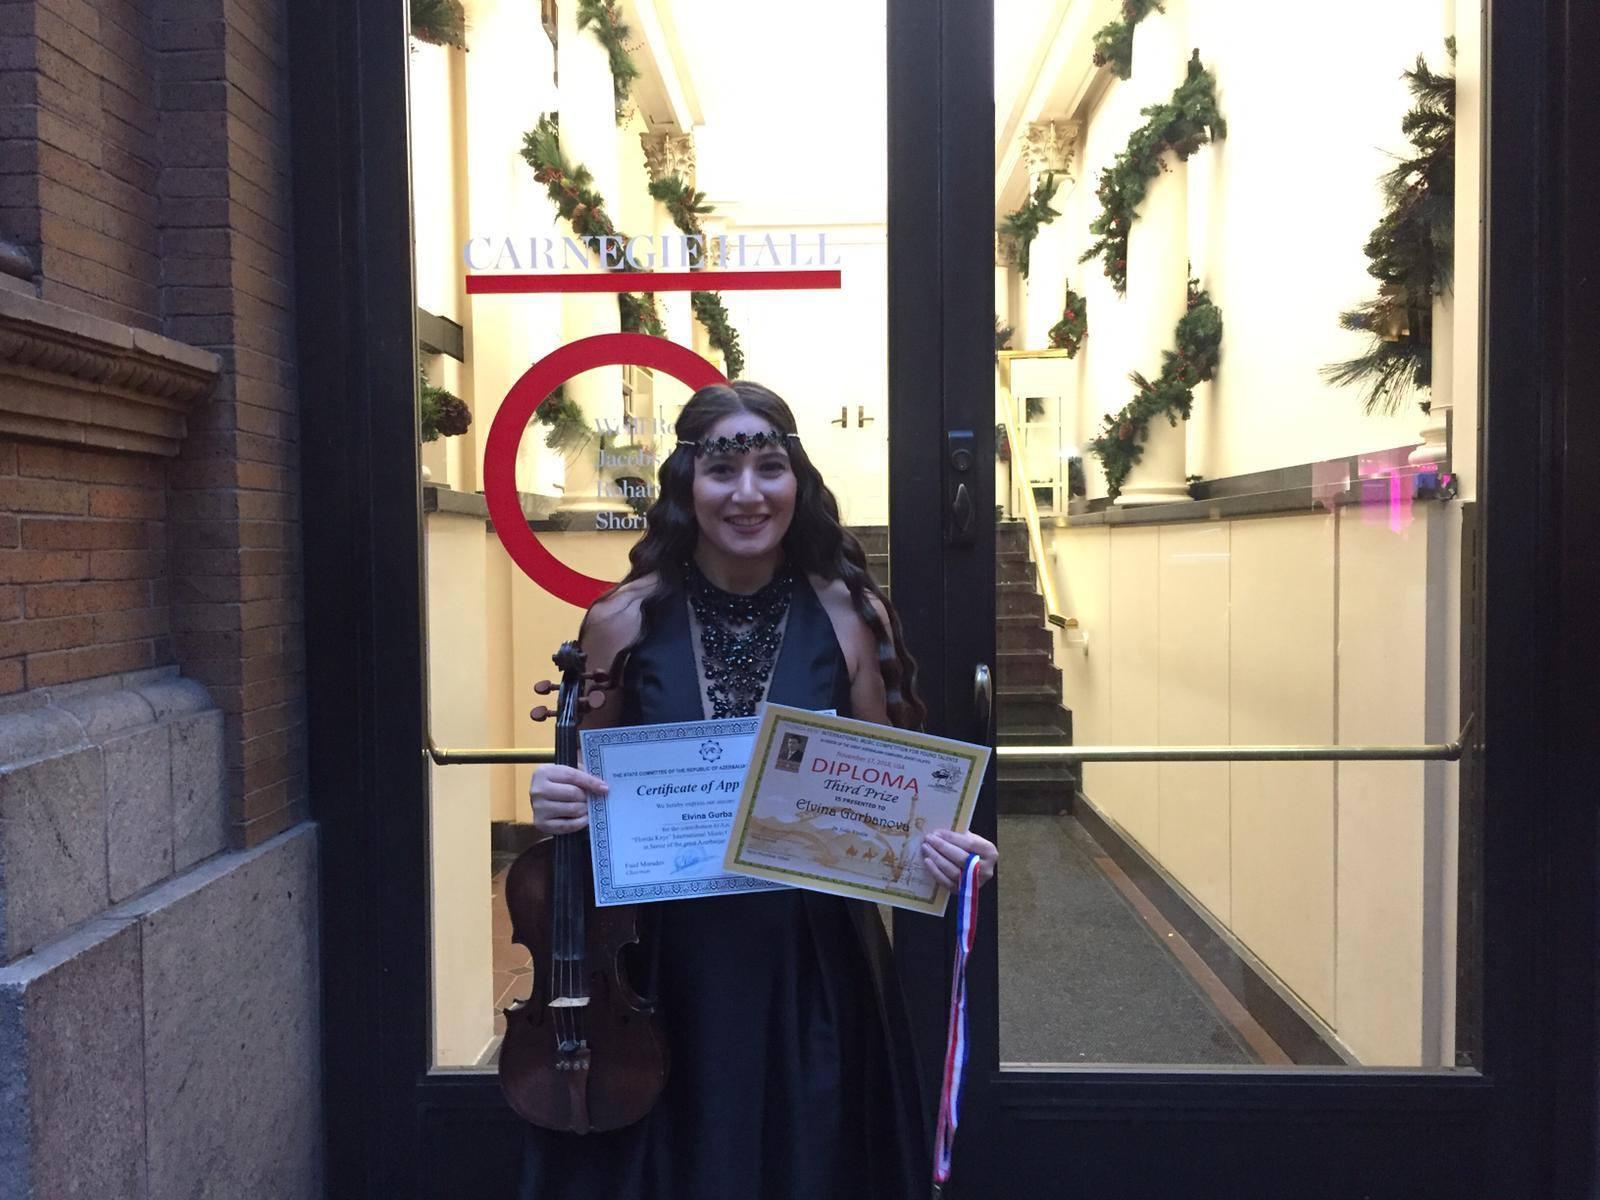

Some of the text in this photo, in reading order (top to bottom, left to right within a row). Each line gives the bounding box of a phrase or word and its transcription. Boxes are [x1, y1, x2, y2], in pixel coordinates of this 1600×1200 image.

[464, 232, 841, 271] CARNEGIE HALL
[595, 511, 648, 529] Shori
[811, 757, 919, 794] DIPLOMA
[636, 783, 698, 798] Certificate
[701, 779, 716, 794] of
[824, 778, 899, 804] Third Prize
[796, 798, 910, 832] Elvina Gurbanova
[842, 797, 877, 809] PRESENTED
[878, 804, 886, 812] TO
[681, 812, 706, 821] Elvina
